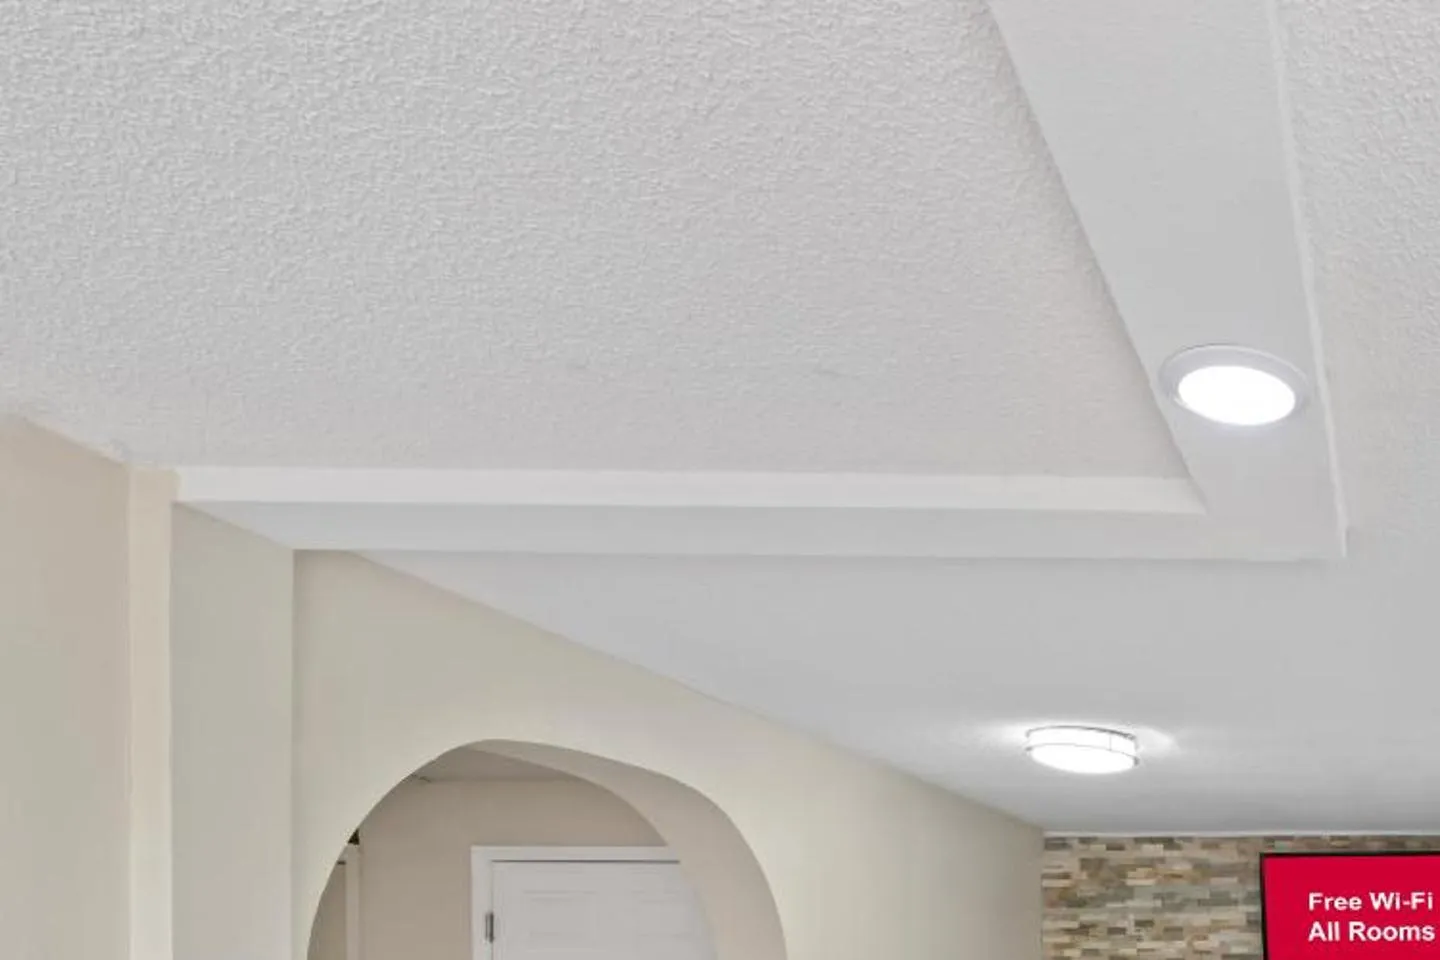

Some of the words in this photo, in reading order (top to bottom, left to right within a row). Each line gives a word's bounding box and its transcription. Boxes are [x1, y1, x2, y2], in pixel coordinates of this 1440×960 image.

[1308, 892, 1362, 911] Free
[1369, 892, 1433, 911] Wi-Fi
[1308, 921, 1340, 942] All
[1348, 921, 1436, 942] Rooms
